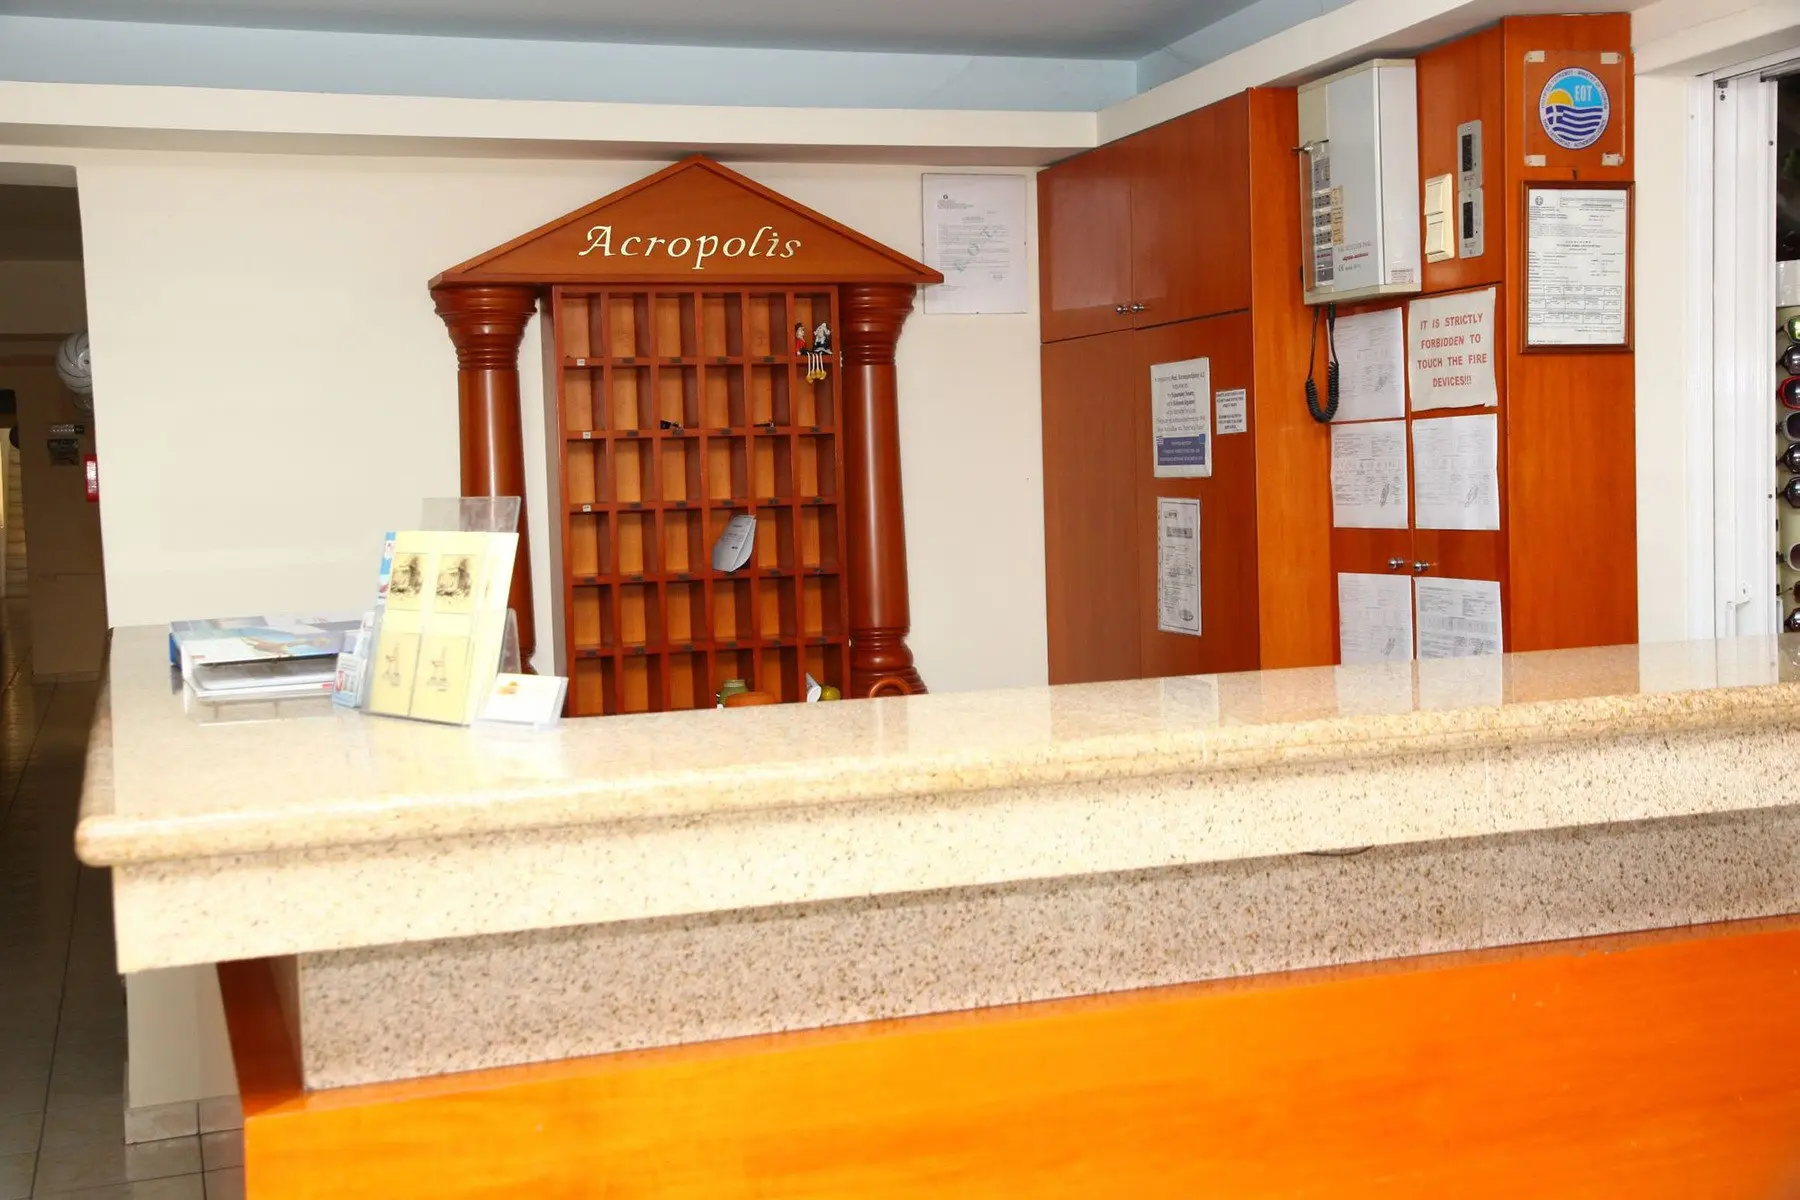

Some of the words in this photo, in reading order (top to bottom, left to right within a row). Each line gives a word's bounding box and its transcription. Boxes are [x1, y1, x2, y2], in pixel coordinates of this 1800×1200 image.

[1575, 85, 1593, 102] EOT
[578, 224, 802, 270] Acropolis
[1420, 320, 1428, 330] IT
[1432, 318, 1440, 329] IS
[1444, 313, 1483, 327] STRICTLY
[1421, 336, 1464, 349] FORBIDDEN
[1470, 333, 1481, 344] TO
[1417, 358, 1443, 369] TOUCH
[1447, 356, 1463, 367] THE
[1468, 353, 1488, 365] FIRE
[1432, 375, 1472, 387] DEVICES!!!
